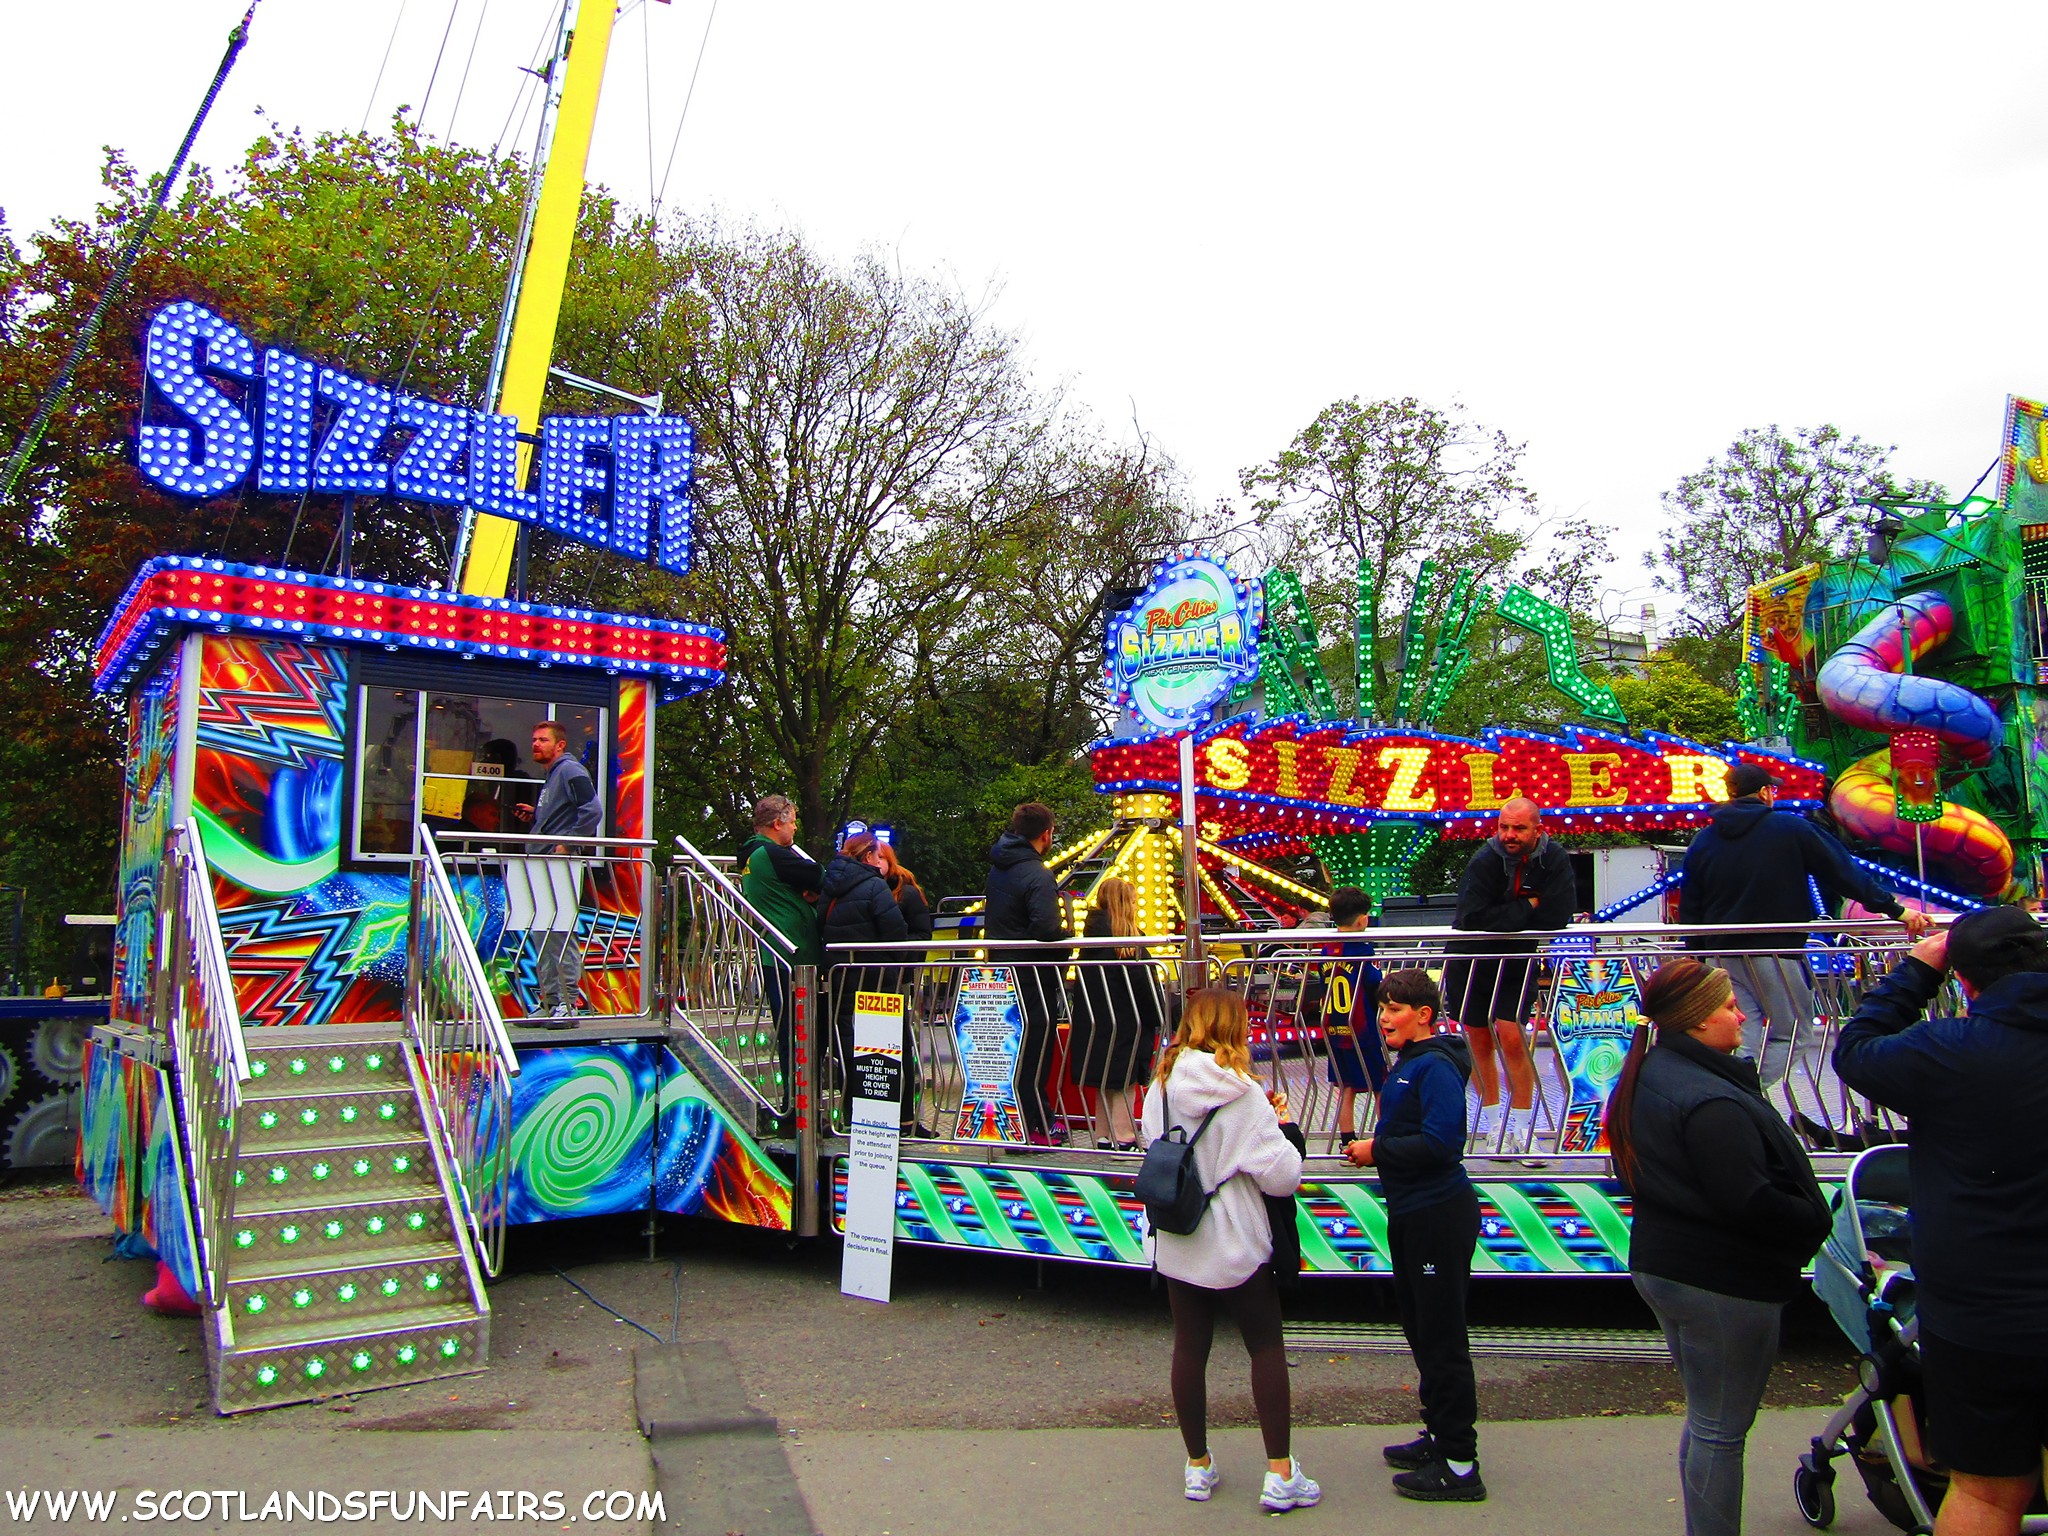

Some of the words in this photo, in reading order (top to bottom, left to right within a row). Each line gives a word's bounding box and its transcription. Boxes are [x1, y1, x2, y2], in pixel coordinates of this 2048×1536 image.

[139, 300, 694, 575] SIZZLER
[1146, 608, 1172, 636] Pat
[1173, 600, 1218, 627] Collins
[1119, 611, 1248, 681] SIZZLER
[1145, 668, 1166, 678] NEXT
[477, 766, 501, 775] £4.00
[1206, 737, 1730, 811] SIZZLER
[857, 994, 901, 1013] SIZZLER
[1557, 1001, 1639, 1042] SIZZLER
[874, 1066, 883, 1074] BE
[884, 1067, 897, 1075] THIS
[865, 1073, 888, 1081] HEIGHT
[873, 1082, 890, 1090] OVER
[869, 1130, 885, 1138] height
[867, 1141, 891, 1149] attendant
[874, 1152, 893, 1161] joining
[861, 1235, 886, 1244] operators
[847, 1243, 868, 1251] decision
